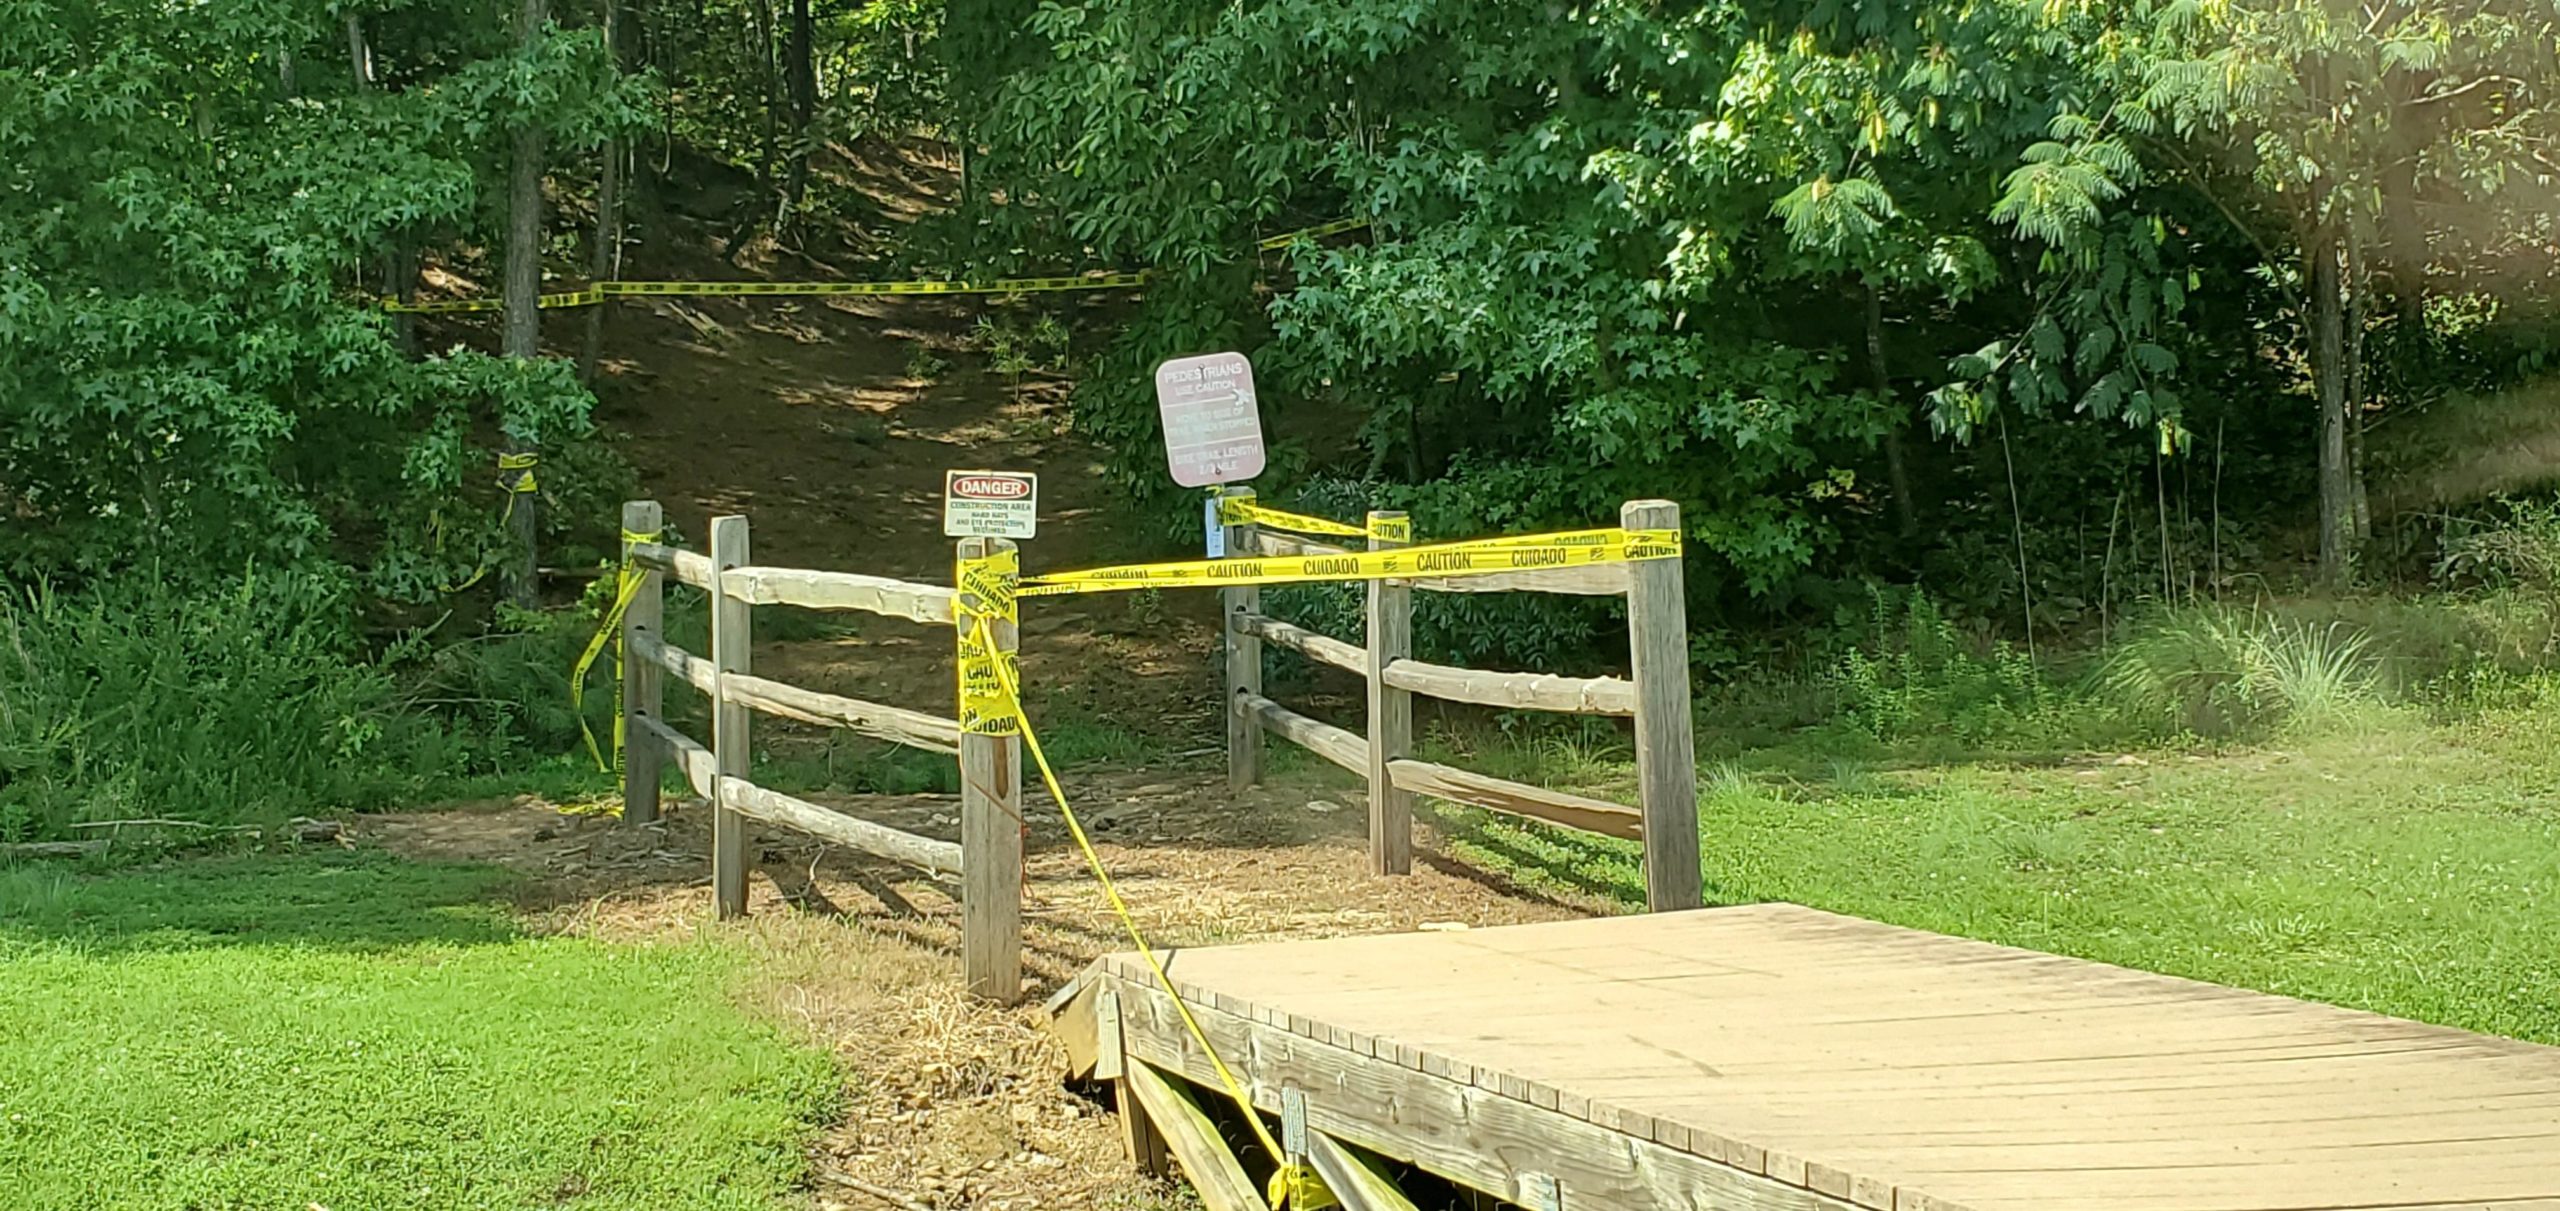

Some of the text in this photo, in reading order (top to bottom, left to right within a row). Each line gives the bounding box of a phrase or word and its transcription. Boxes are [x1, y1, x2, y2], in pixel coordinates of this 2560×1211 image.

[1164, 362, 1243, 383] PEDESTRIANS
[1175, 380, 1236, 396] USE CAUTION
[1232, 406, 1244, 416] OF
[1223, 444, 1258, 458] LENGTH
[961, 480, 1022, 494] DANGER
[951, 502, 1031, 511] CONSTRUCTION AREA
[1377, 522, 1405, 539] UTION
[1206, 563, 1262, 578] CAUTION
[1303, 558, 1359, 575] CUIDADO
[1416, 552, 1471, 571] CAUTION
[1511, 547, 1566, 567] CUIDADO
[1623, 545, 1677, 559] CAUTION
